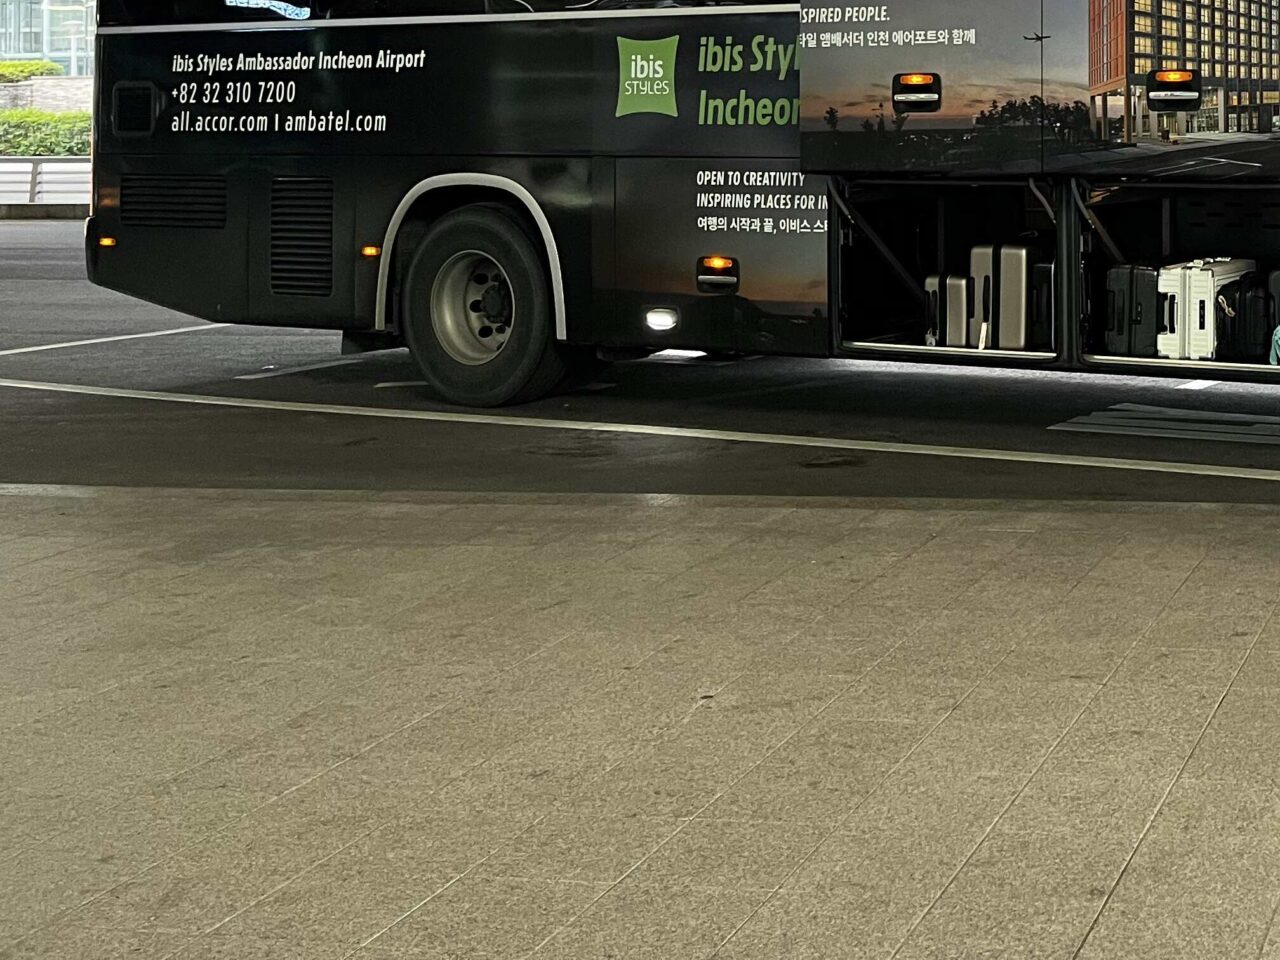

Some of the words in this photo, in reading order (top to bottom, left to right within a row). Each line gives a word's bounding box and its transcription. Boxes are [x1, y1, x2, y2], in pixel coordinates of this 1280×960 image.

[800, 8, 842, 23] SPIRED
[845, 6, 890, 22] PEOPLE.
[820, 31, 864, 48] 앰배서더
[867, 31, 889, 46] 인천
[892, 29, 949, 46] 에어포트와
[952, 28, 976, 45] 함께
[172, 54, 194, 72] ibis
[196, 54, 233, 76] Styles
[236, 52, 315, 71] Ambassador
[318, 50, 372, 70] Incheon
[376, 49, 426, 73] Airport
[698, 36, 744, 73] ibis
[630, 54, 664, 79] ibis
[172, 82, 197, 104] +82
[202, 82, 220, 103] 32
[226, 81, 251, 103] 310
[258, 81, 296, 103] 7200
[171, 110, 268, 132] all.accor.com
[285, 109, 387, 132] ambatel.com
[696, 171, 725, 186] OPEN
[727, 171, 741, 186] TO
[743, 171, 805, 187] CREATIVITY
[696, 193, 751, 209] INSPIRING
[753, 194, 792, 209] PLACES
[794, 194, 815, 210] FOR
[697, 216, 728, 232] 여행의
[729, 217, 761, 233] 시작과
[763, 218, 777, 235] 끝,
[779, 218, 811, 234] 이비스
[813, 219, 828, 233] 스
